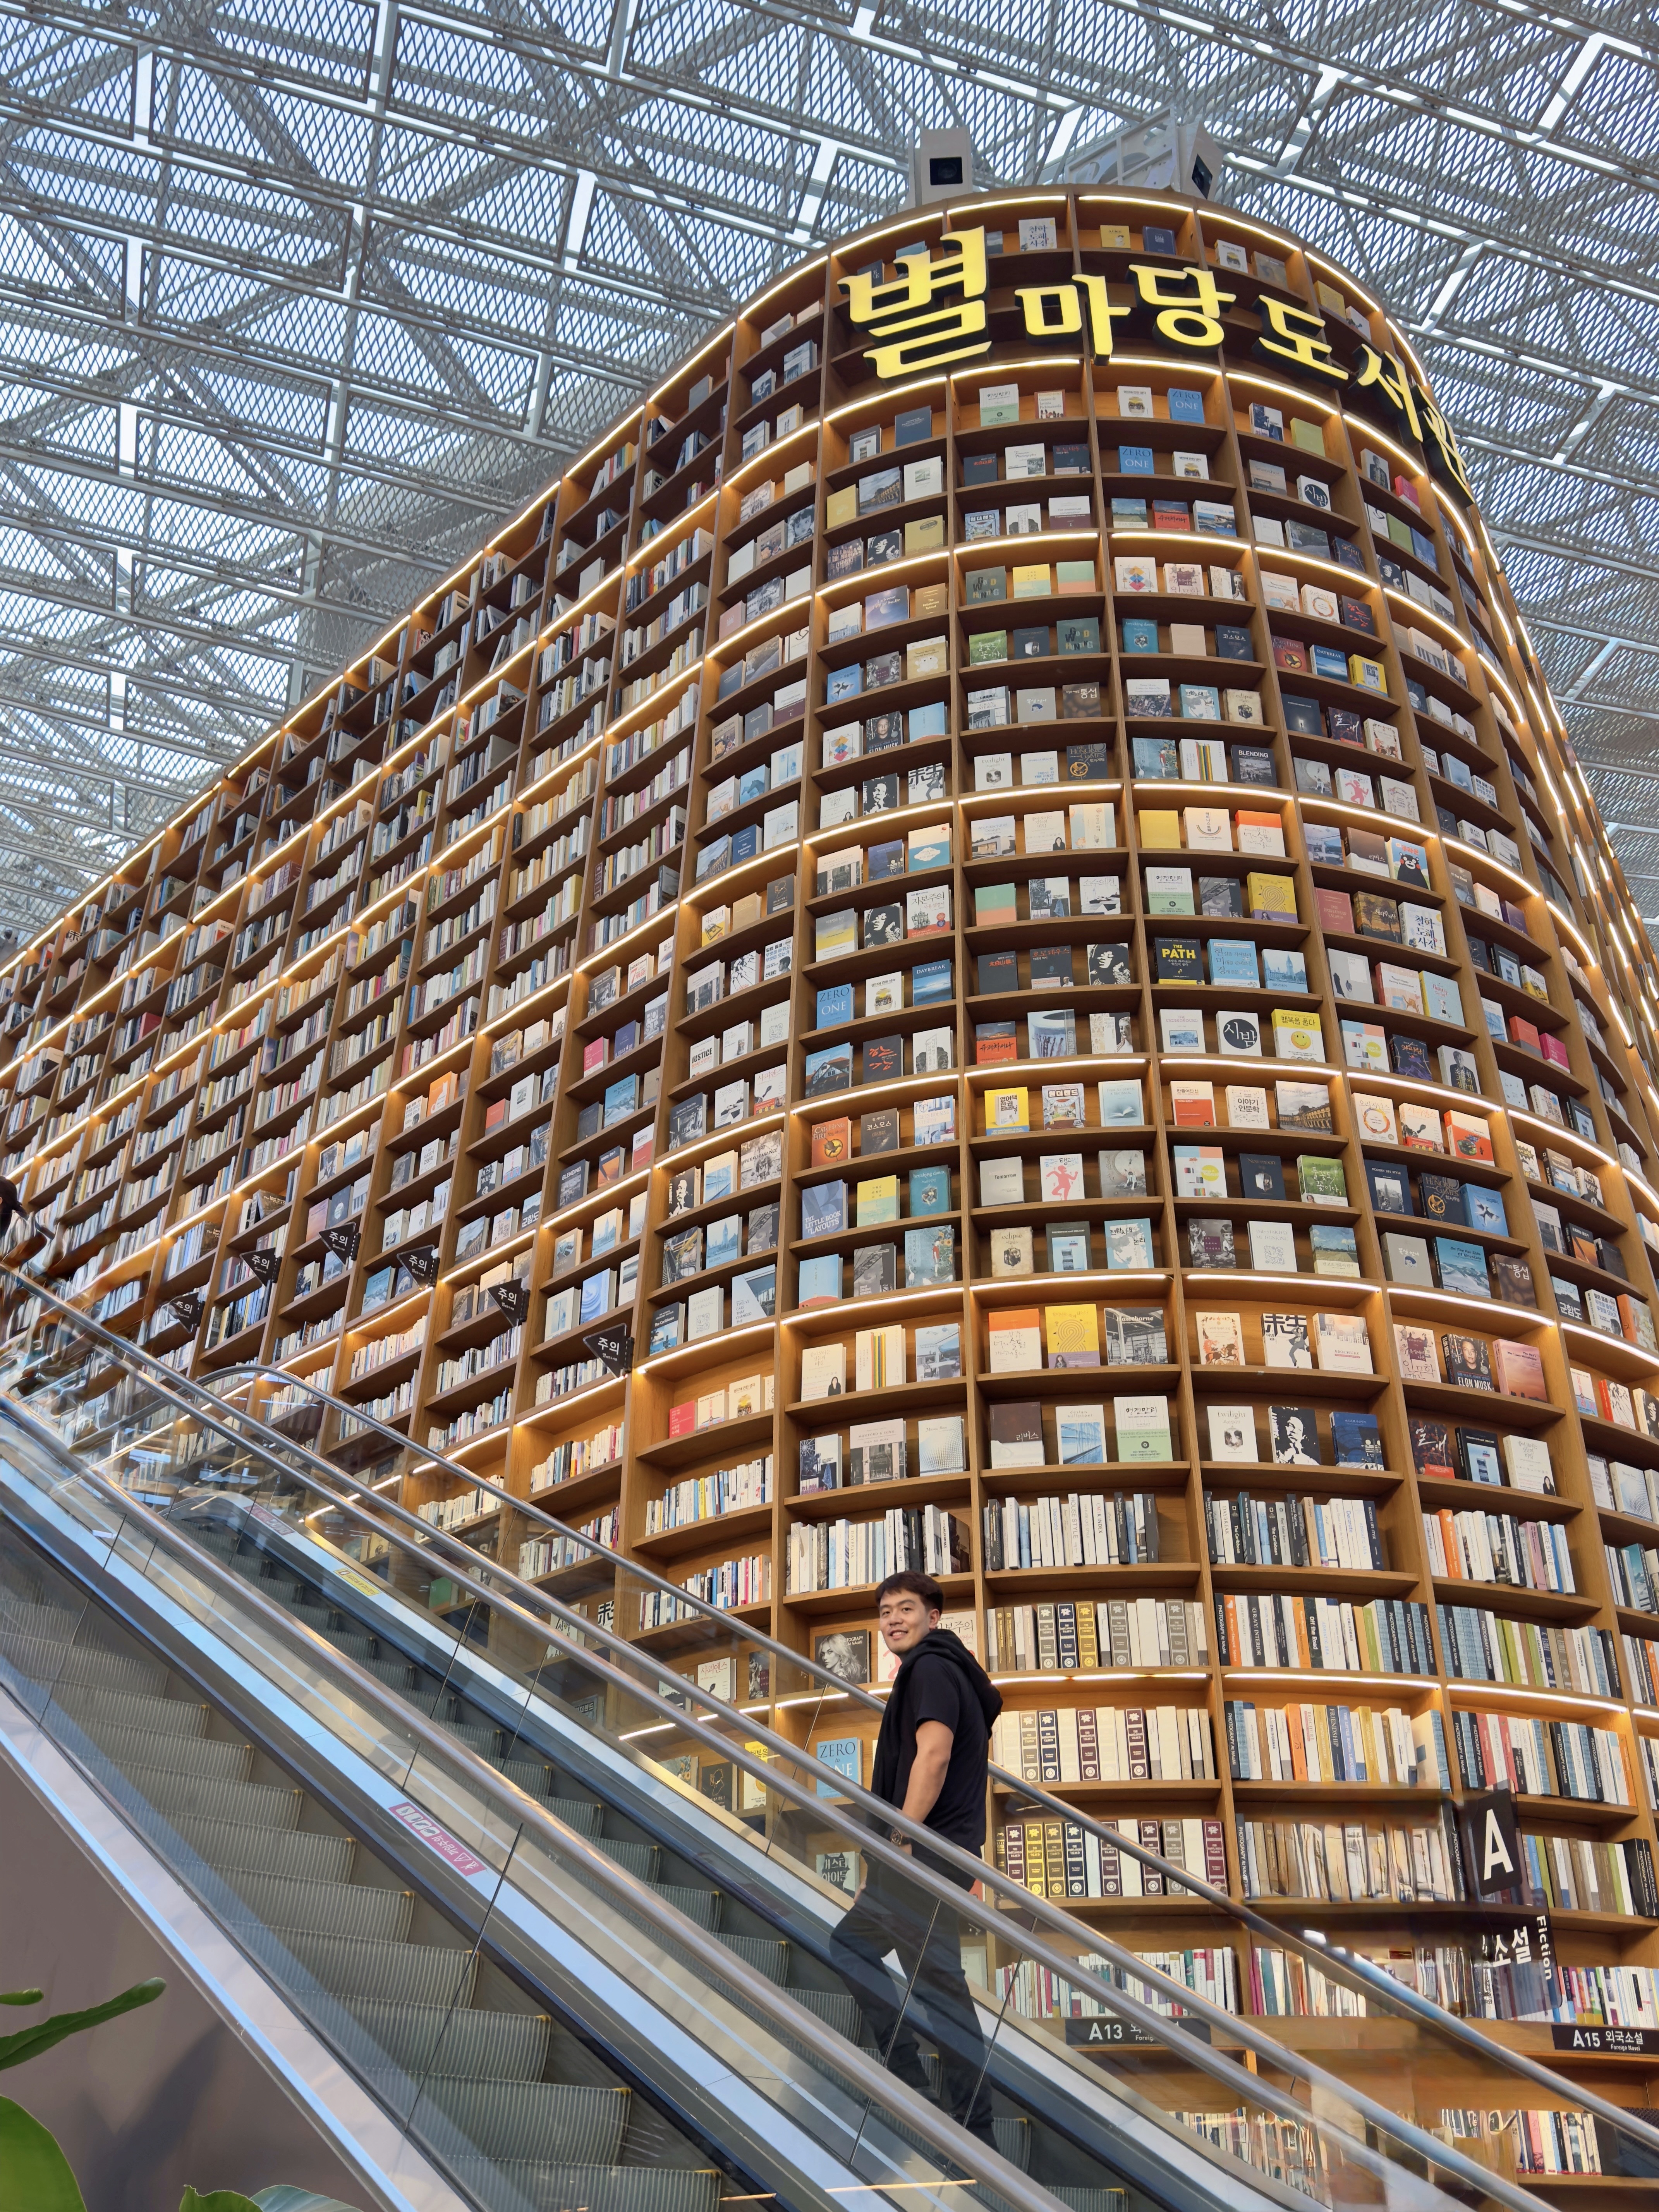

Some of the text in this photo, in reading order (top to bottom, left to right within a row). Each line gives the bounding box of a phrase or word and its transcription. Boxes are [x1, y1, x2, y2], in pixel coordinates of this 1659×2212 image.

[1172, 390, 1200, 400] ZERO
[1175, 400, 1198, 410] ONE
[1122, 447, 1151, 457] ZERO
[1125, 459, 1149, 468] ONE
[1223, 633, 1246, 641] 코스모스
[1317, 649, 1341, 658] DAYBREAK
[1080, 688, 1097, 699] 통섭
[868, 742, 898, 754] ELON MUSK
[1238, 750, 1269, 758] BLENDING
[1369, 854, 1386, 862] 리버스
[912, 891, 945, 905] 자본주의
[1162, 949, 1196, 959] PATH
[916, 964, 945, 975] DAYBREAK
[819, 987, 849, 1002] ZERO
[821, 1002, 847, 1015] ONE
[1281, 1016, 1315, 1026] 행복을 풀다
[1224, 1022, 1257, 1048] 시밤
[979, 1042, 1014, 1051] 슈퍼차이나
[691, 1048, 712, 1064] JUSTICE
[757, 1068, 784, 1080] 사피엔스
[1048, 1088, 1079, 1098] 원더랜드
[676, 1102, 696, 1115] Subway Station
[1238, 1105, 1259, 1113] 인문학
[1358, 1100, 1391, 1111] 오리지널스
[1407, 1107, 1437, 1118] 사피엔스
[814, 1123, 845, 1134] CATCHING
[867, 1121, 891, 1131] 코스모스
[813, 1132, 827, 1140] FIRE
[744, 1147, 778, 1164] PERFORMANCE
[562, 1167, 581, 1181] BLENDING
[805, 1211, 841, 1230] LITTLE BOOK
[810, 1218, 840, 1234] LAYOUTS
[1110, 1226, 1137, 1236] 전환시대의
[330, 1231, 348, 1247] 주의
[1133, 1237, 1145, 1245] 논리
[252, 1254, 270, 1269] 주의
[409, 1255, 427, 1271] 주의
[1513, 1265, 1530, 1280] 통섭
[498, 1287, 517, 1305] 주의
[1559, 1302, 1582, 1320] 군함도
[660, 1317, 675, 1325] Caribbean
[598, 1337, 619, 1355] 주의
[1458, 1376, 1492, 1391] ELON MUSK
[1126, 1406, 1158, 1415] 명견만리
[1218, 1411, 1246, 1419] twilight
[1016, 1431, 1039, 1441] 리버스
[701, 1662, 728, 1676] 사피엔스
[1329, 1708, 1338, 1747] FRIENDSHIP
[1473, 1724, 1481, 1755] PHOTOGRAPY
[820, 1742, 855, 1758] ZERO
[1557, 1734, 1565, 1763] PHOTOGRAPY
[1484, 1809, 1514, 1881] A
[1493, 1926, 1532, 1967] 소설
[1537, 1915, 1552, 1980] Fiction
[1089, 2022, 1123, 2040] A13
[1573, 2030, 1644, 2048] A15 외국소설
